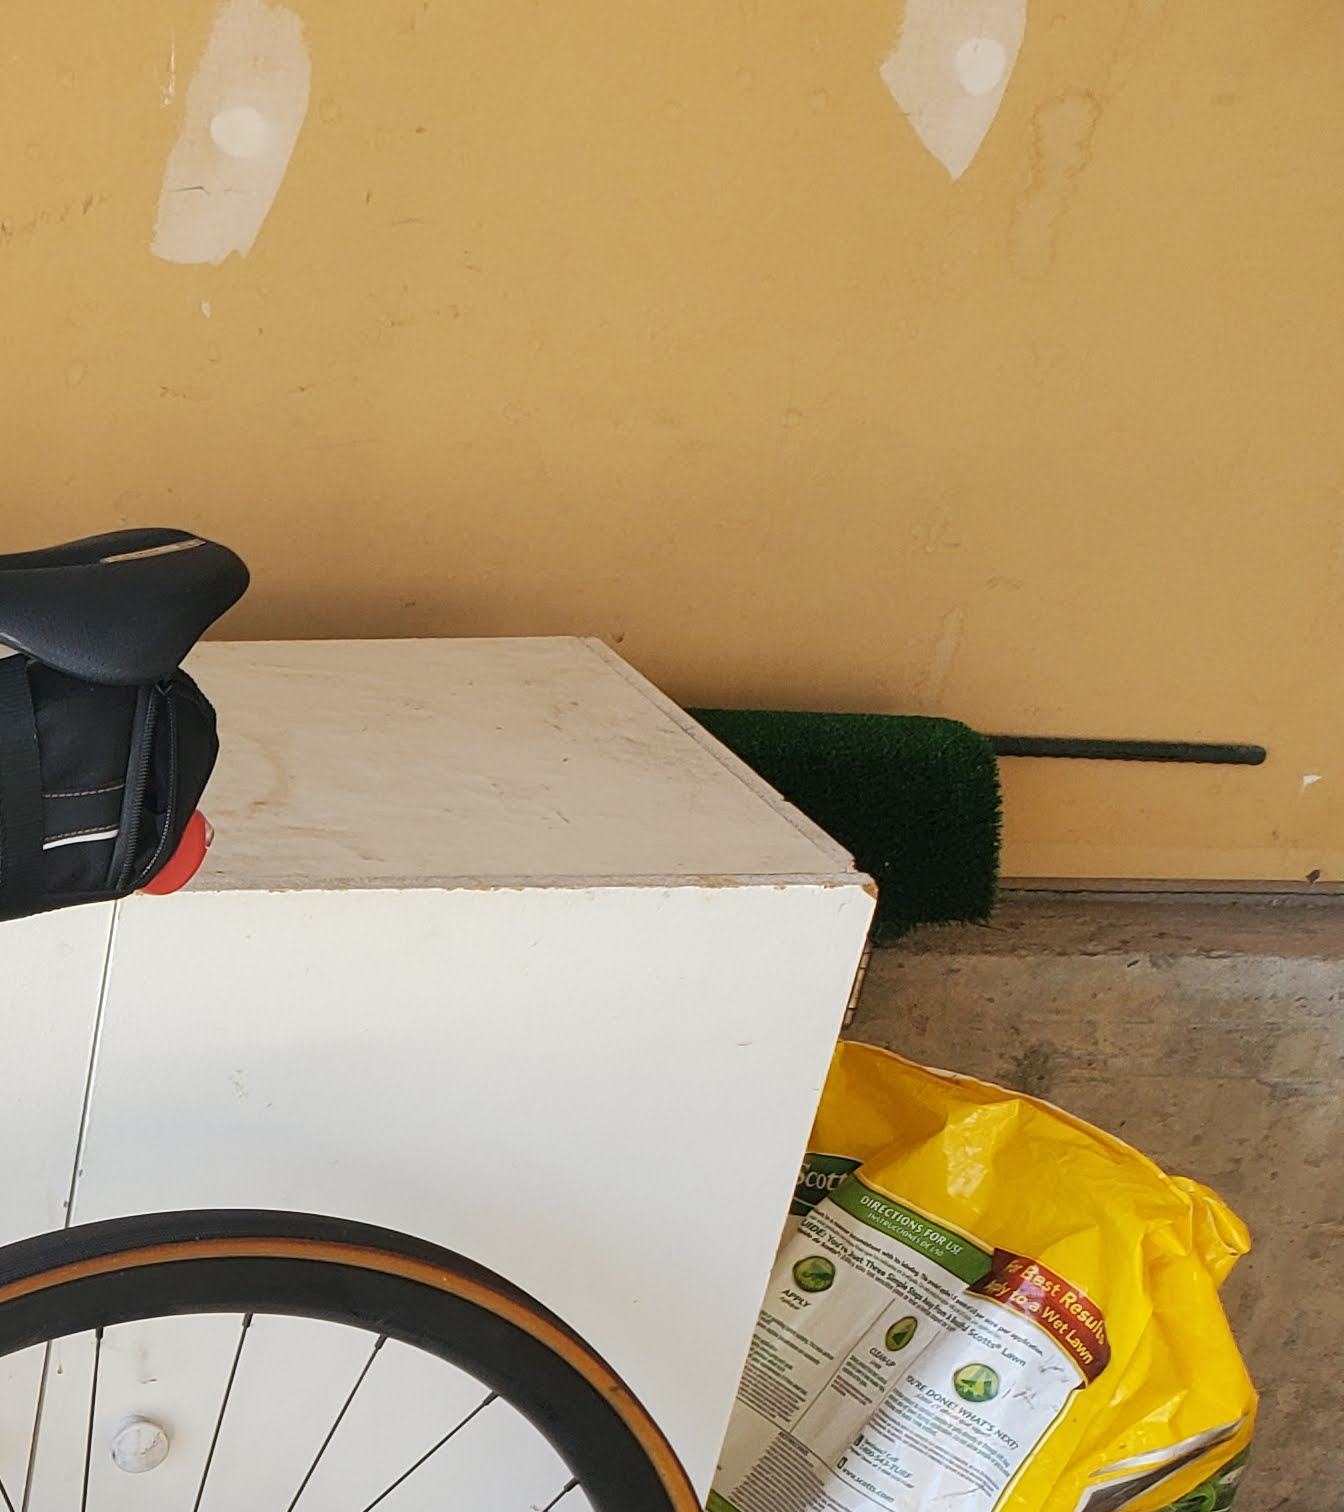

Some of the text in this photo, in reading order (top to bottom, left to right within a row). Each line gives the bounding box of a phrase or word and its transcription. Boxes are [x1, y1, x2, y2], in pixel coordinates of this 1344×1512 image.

[860, 1195, 963, 1256] DIRECTIONS FOR USE
[782, 1289, 811, 1308] APPLY
[1010, 1290, 1028, 1305] to
[1042, 1306, 1070, 1335] Wet
[1065, 1329, 1094, 1365] Lawn
[1021, 1264, 1061, 1297] Best
[1059, 1292, 1105, 1345] Results
[1001, 1347, 1026, 1367] Lawn
